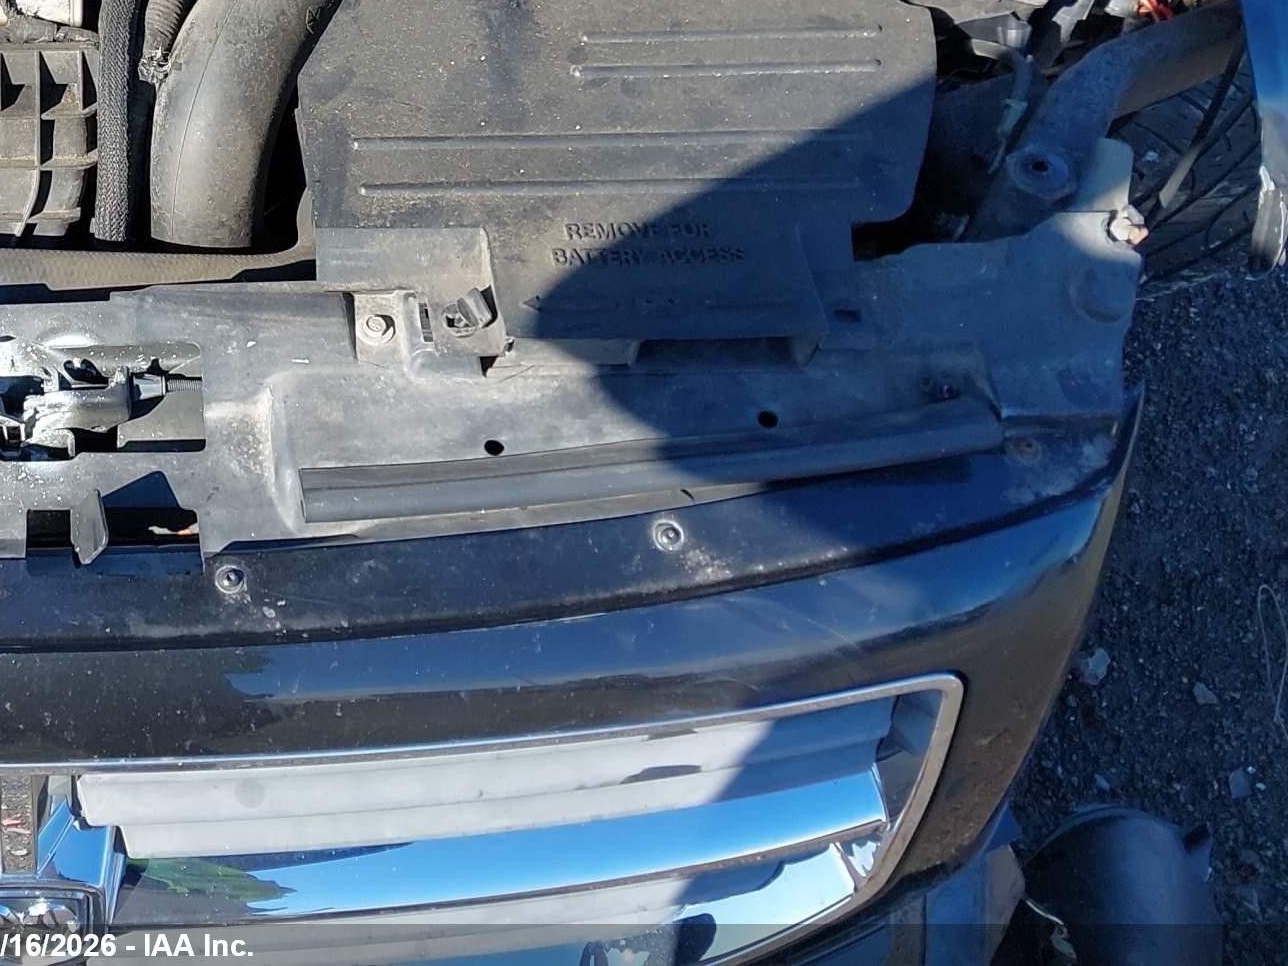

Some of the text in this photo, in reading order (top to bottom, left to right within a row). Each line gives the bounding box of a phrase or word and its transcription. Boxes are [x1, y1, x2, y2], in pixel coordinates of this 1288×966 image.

[565, 221, 712, 241] REMOVE FOR
[551, 247, 744, 266] BATTERY ACCESS
